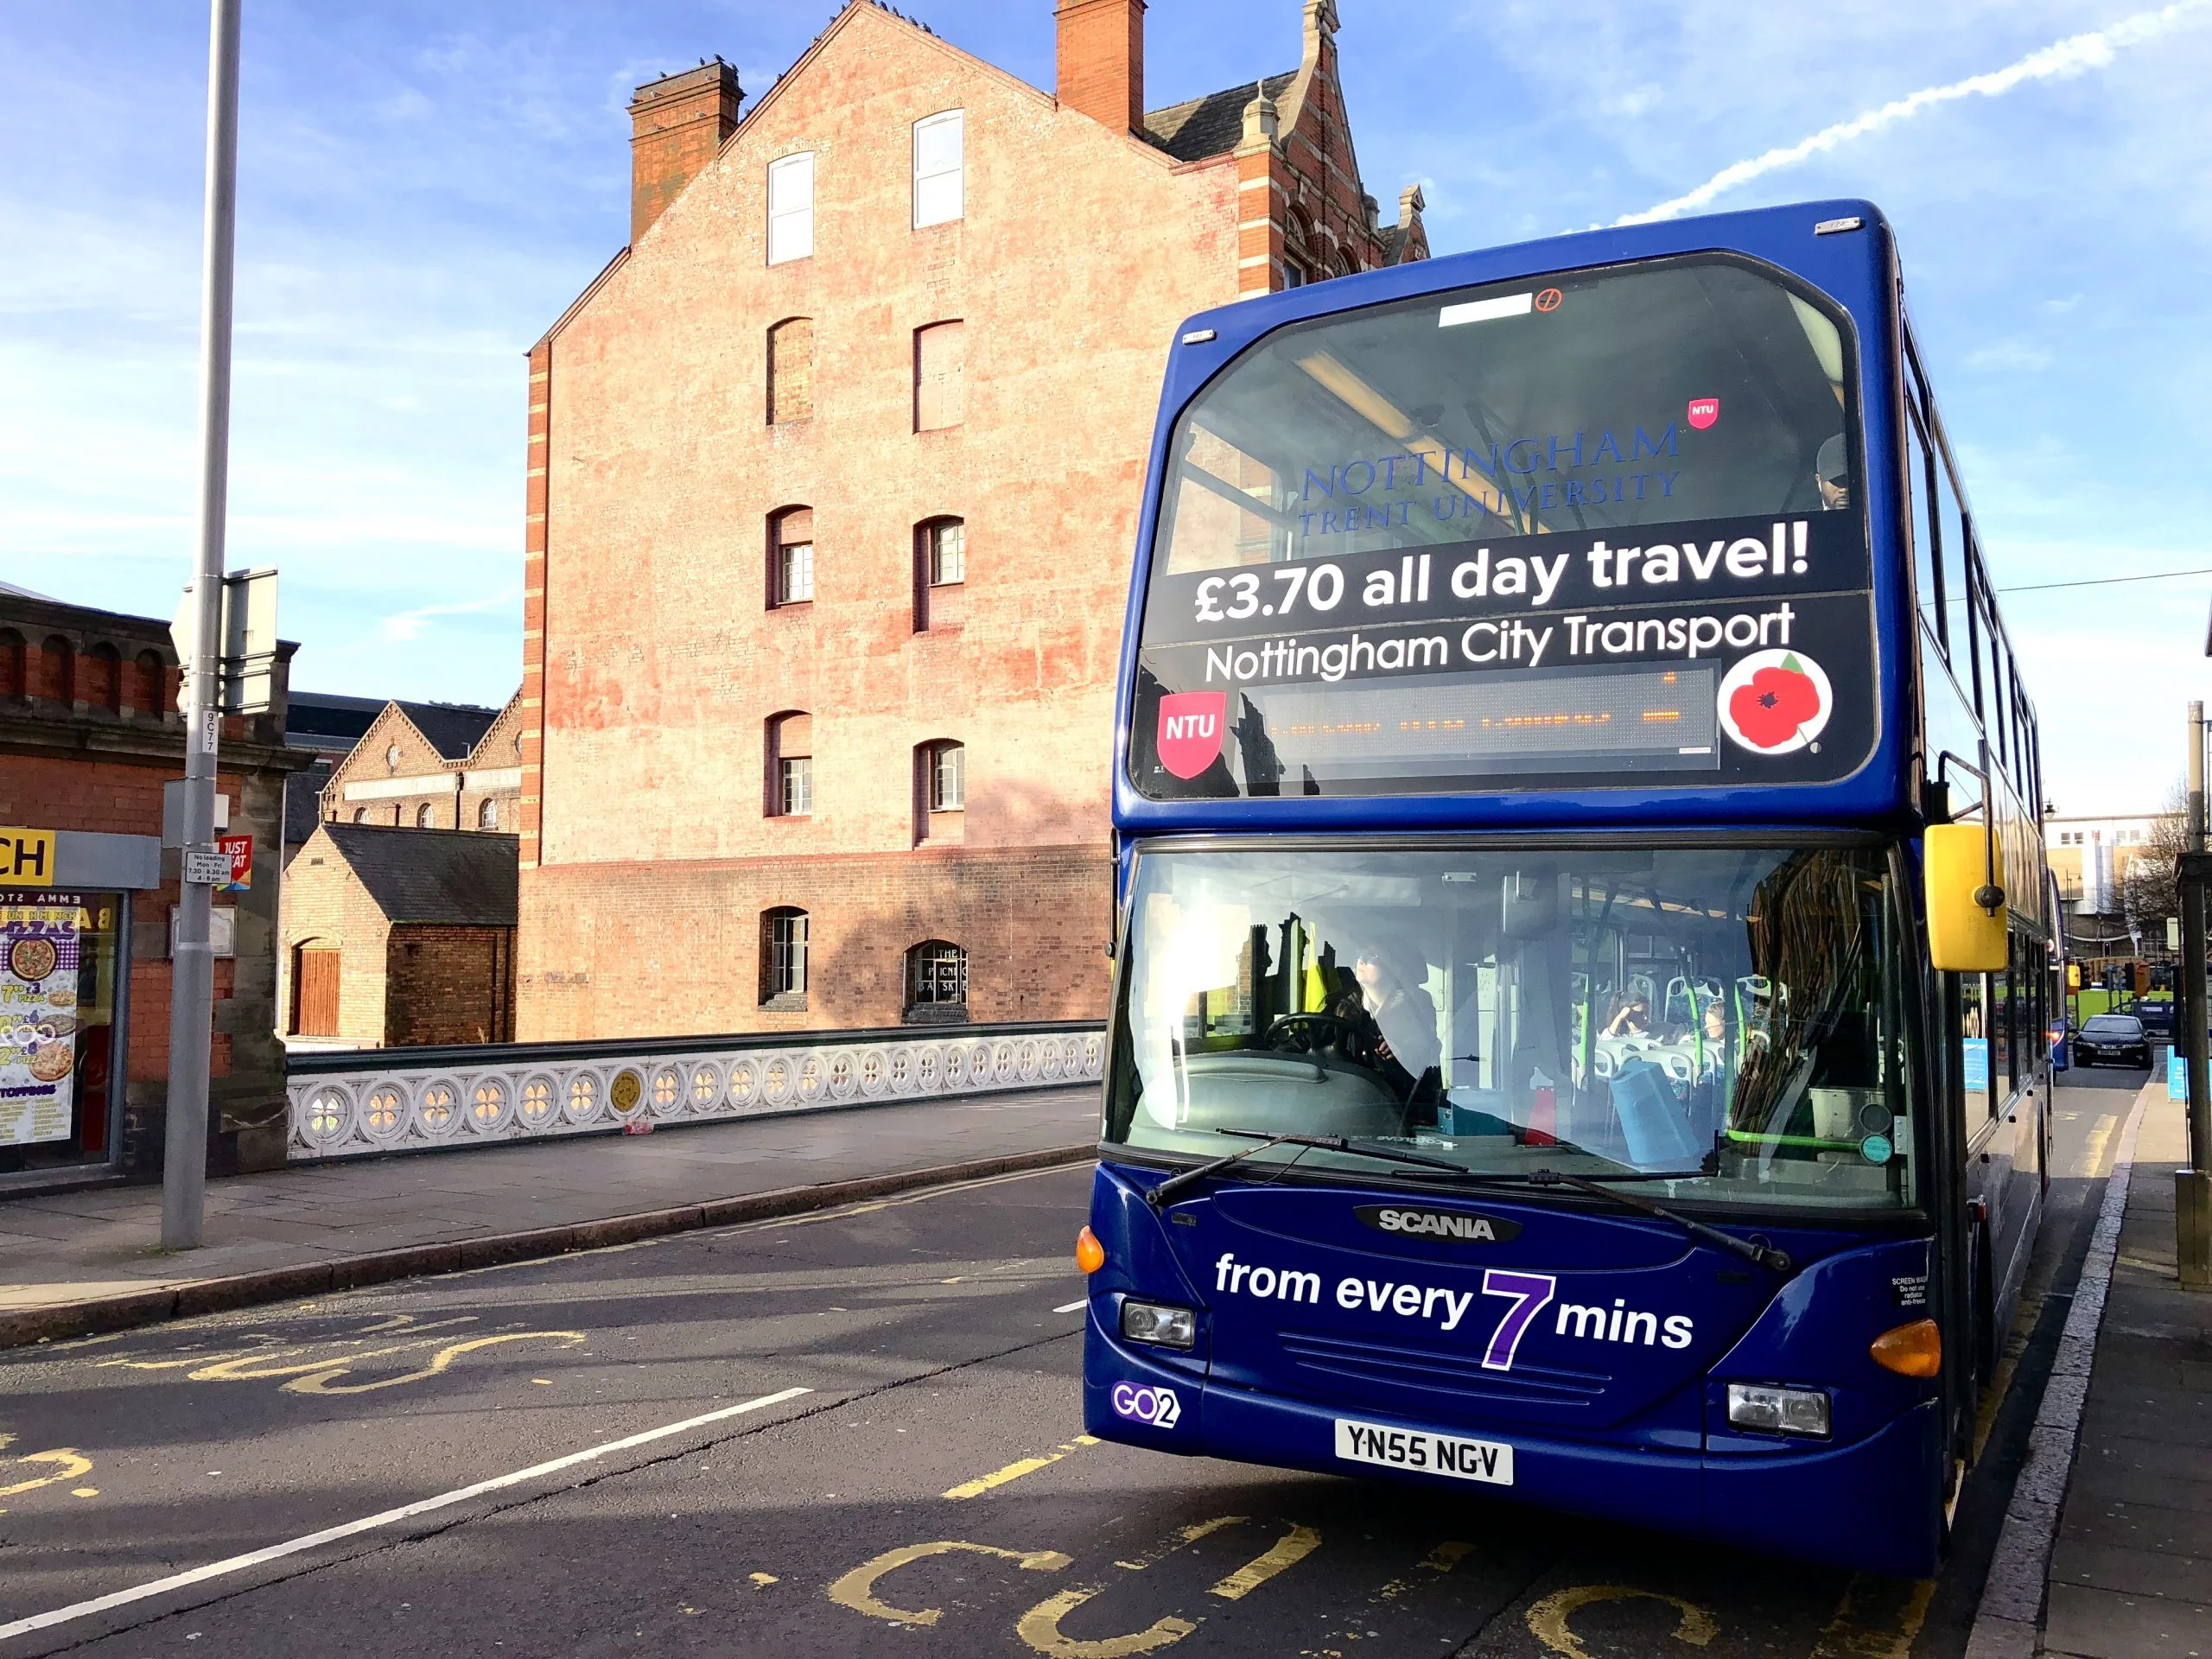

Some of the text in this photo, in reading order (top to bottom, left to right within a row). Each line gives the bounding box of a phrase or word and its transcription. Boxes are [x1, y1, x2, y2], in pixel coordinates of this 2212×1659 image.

[1693, 404, 1714, 415] NTU
[1302, 422, 1681, 501] NOTTINGHAM
[1298, 471, 1681, 537] TRENT UNIVERSITY
[1195, 520, 1809, 623] £3.70 all day travel!
[1205, 601, 1796, 683] Nottingham City Transport
[1166, 714, 1216, 740] NTU
[225, 841, 248, 855] JUST
[17, 993, 46, 1003] PIZZA
[1379, 1210, 1495, 1241] SCANIA
[1215, 1253, 1694, 1370] from every 7 mins
[1113, 1382, 1178, 1426] GO2
[1348, 1424, 1498, 1478] YN55 NGV
